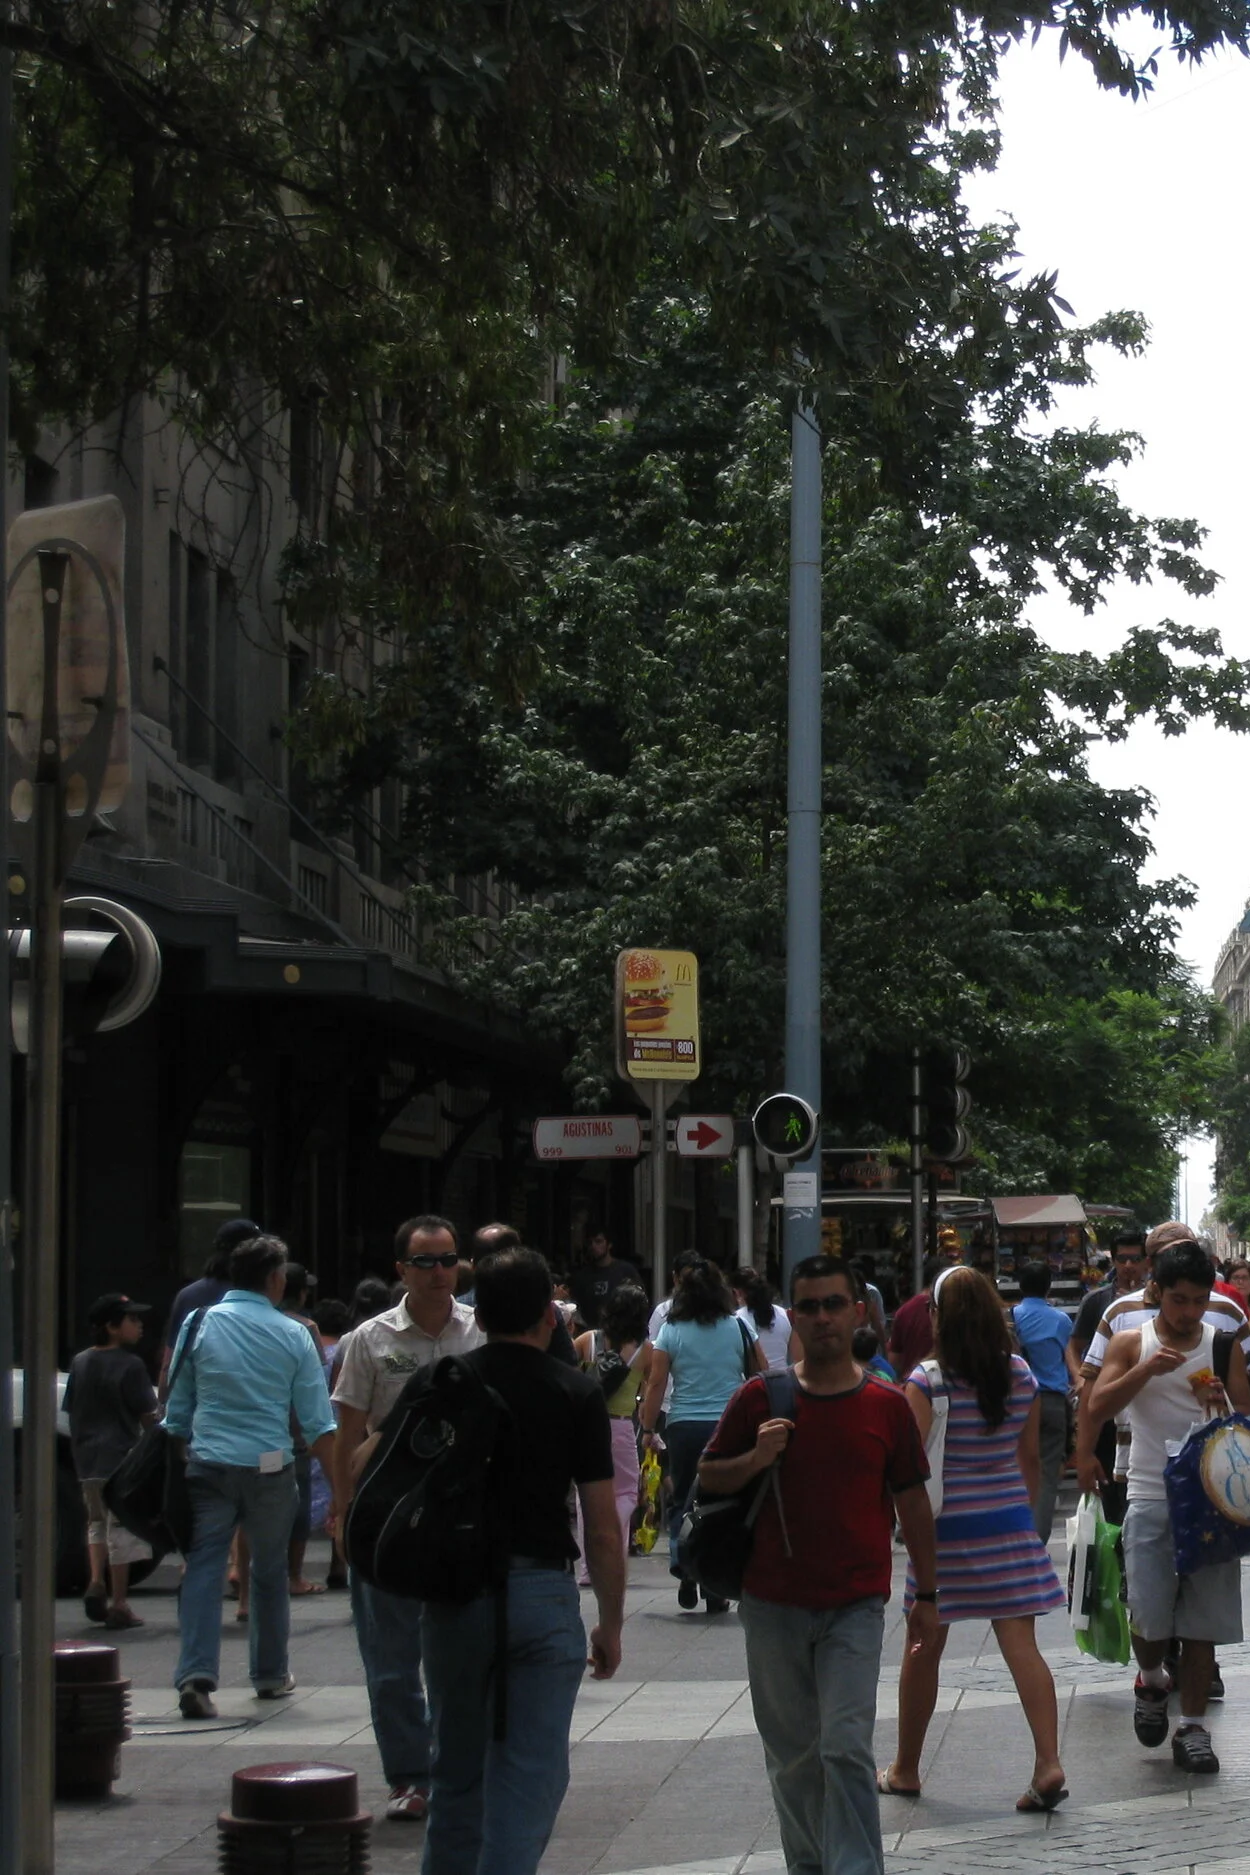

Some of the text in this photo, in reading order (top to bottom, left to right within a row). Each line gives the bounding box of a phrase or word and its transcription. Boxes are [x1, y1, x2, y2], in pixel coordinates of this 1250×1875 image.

[563, 1121, 613, 1138] AGUSTINAS
[542, 1143, 632, 1157] 999 901
